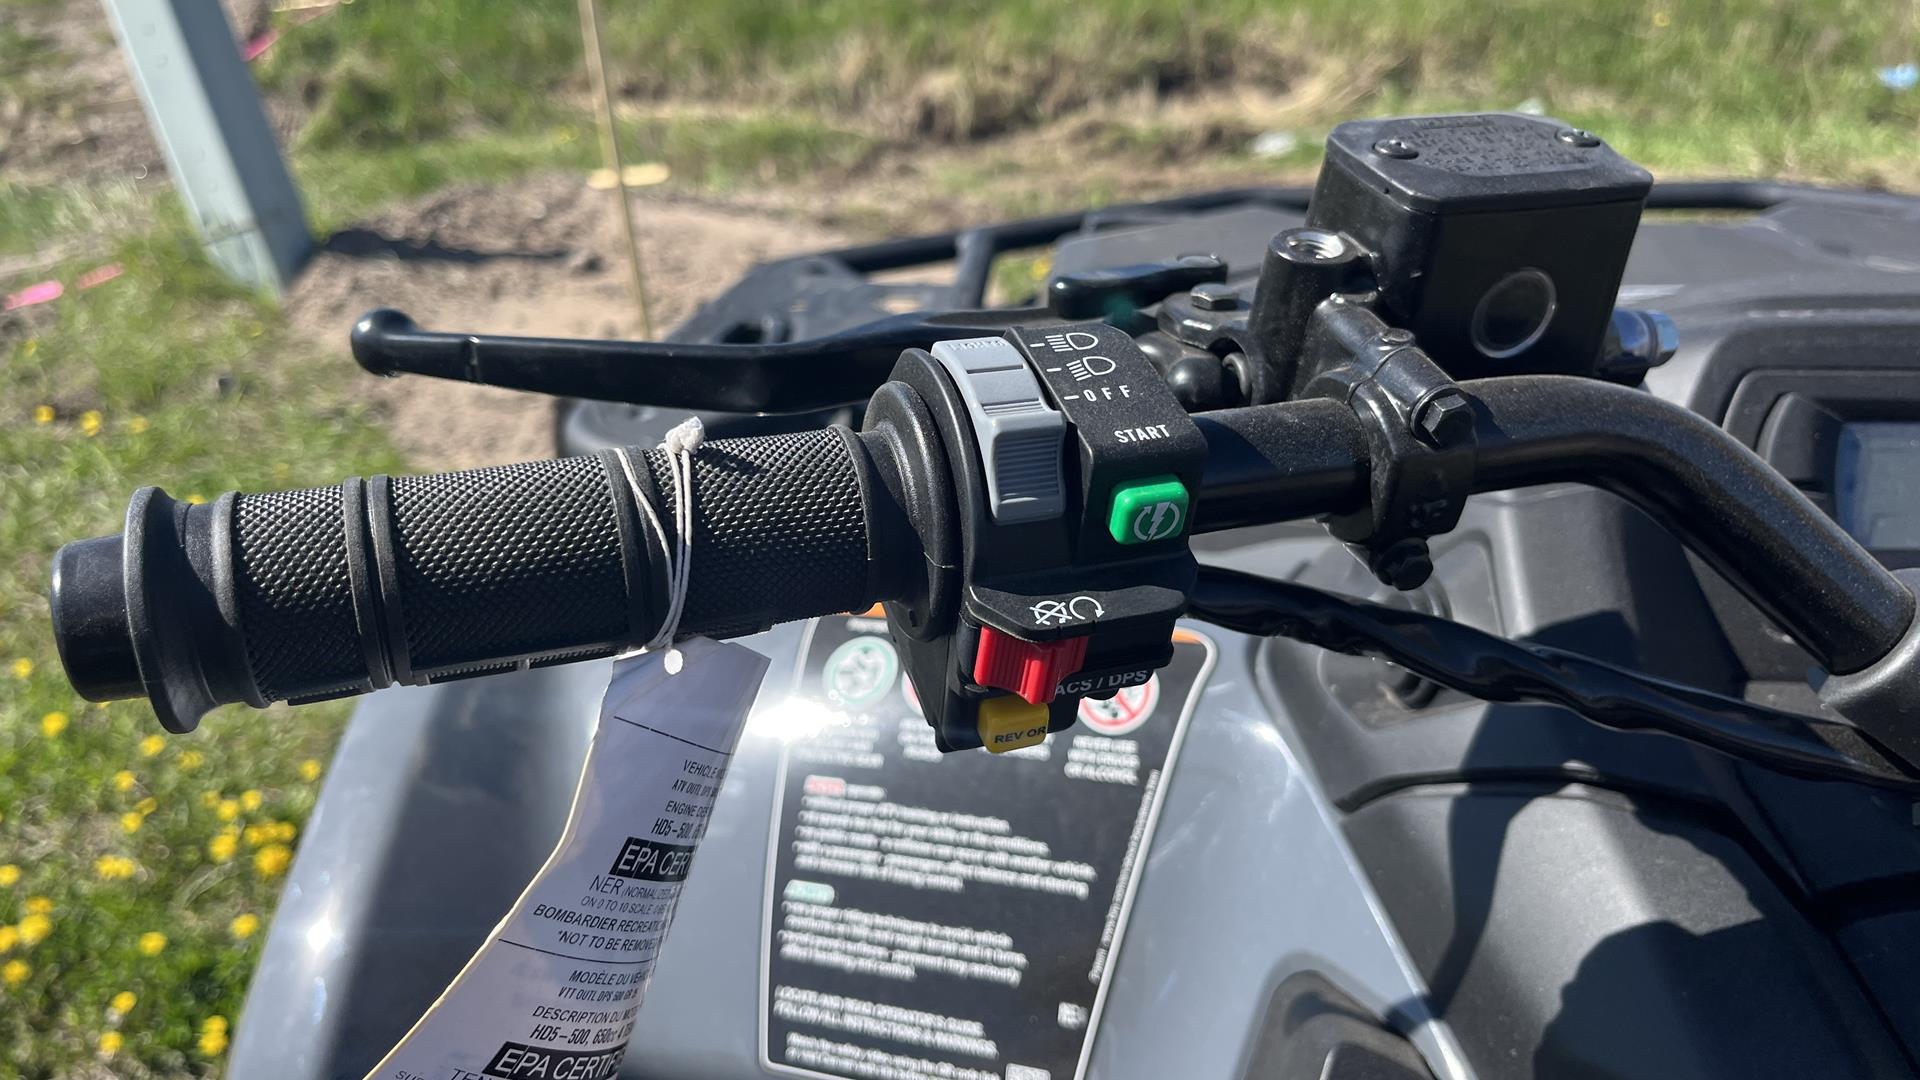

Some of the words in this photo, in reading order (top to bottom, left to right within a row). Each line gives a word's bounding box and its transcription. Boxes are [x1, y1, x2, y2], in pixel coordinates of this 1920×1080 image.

[1114, 424, 1170, 443] START
[1056, 679, 1092, 696] ACS
[1108, 669, 1148, 686] DPS
[994, 731, 1023, 744] REV
[683, 759, 717, 779] VEHICLE
[665, 800, 698, 817] ENGINE
[618, 844, 660, 874] EPA
[589, 875, 625, 896] NER
[581, 896, 598, 908] ON
[605, 900, 618, 913] TO
[619, 902, 630, 913] 10
[533, 904, 618, 932] BOMBARDIER
[588, 935, 605, 949] TO
[604, 938, 622, 950] BE
[568, 969, 617, 985] MODÈLE
[533, 1005, 610, 1024] DESCRIPTION
[494, 1048, 551, 1079] EPA
